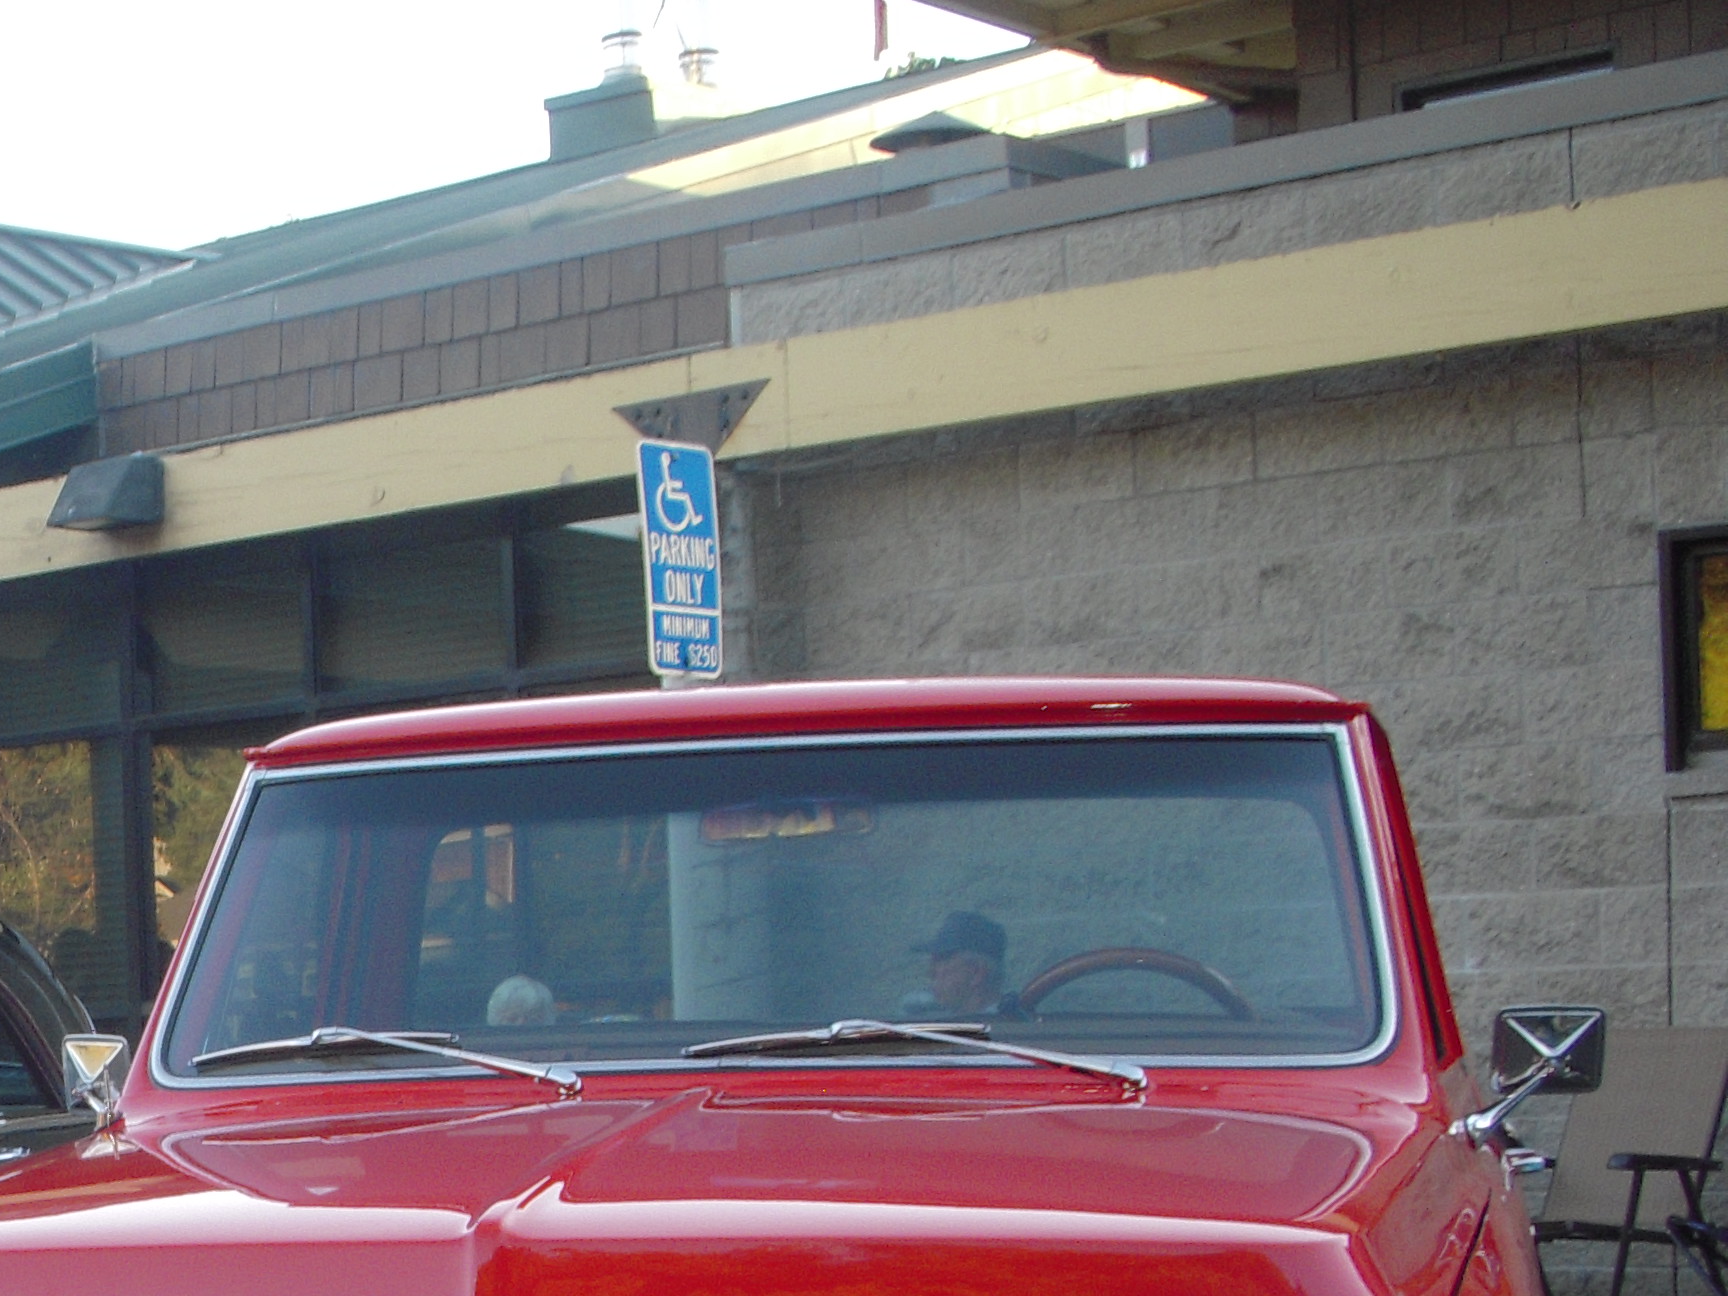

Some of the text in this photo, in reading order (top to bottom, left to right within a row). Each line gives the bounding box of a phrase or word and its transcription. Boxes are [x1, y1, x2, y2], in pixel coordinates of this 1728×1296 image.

[650, 531, 715, 571] PARKING
[665, 569, 705, 605] ONLY
[662, 614, 710, 639] MINIMUM
[655, 641, 718, 668] FINE $250
